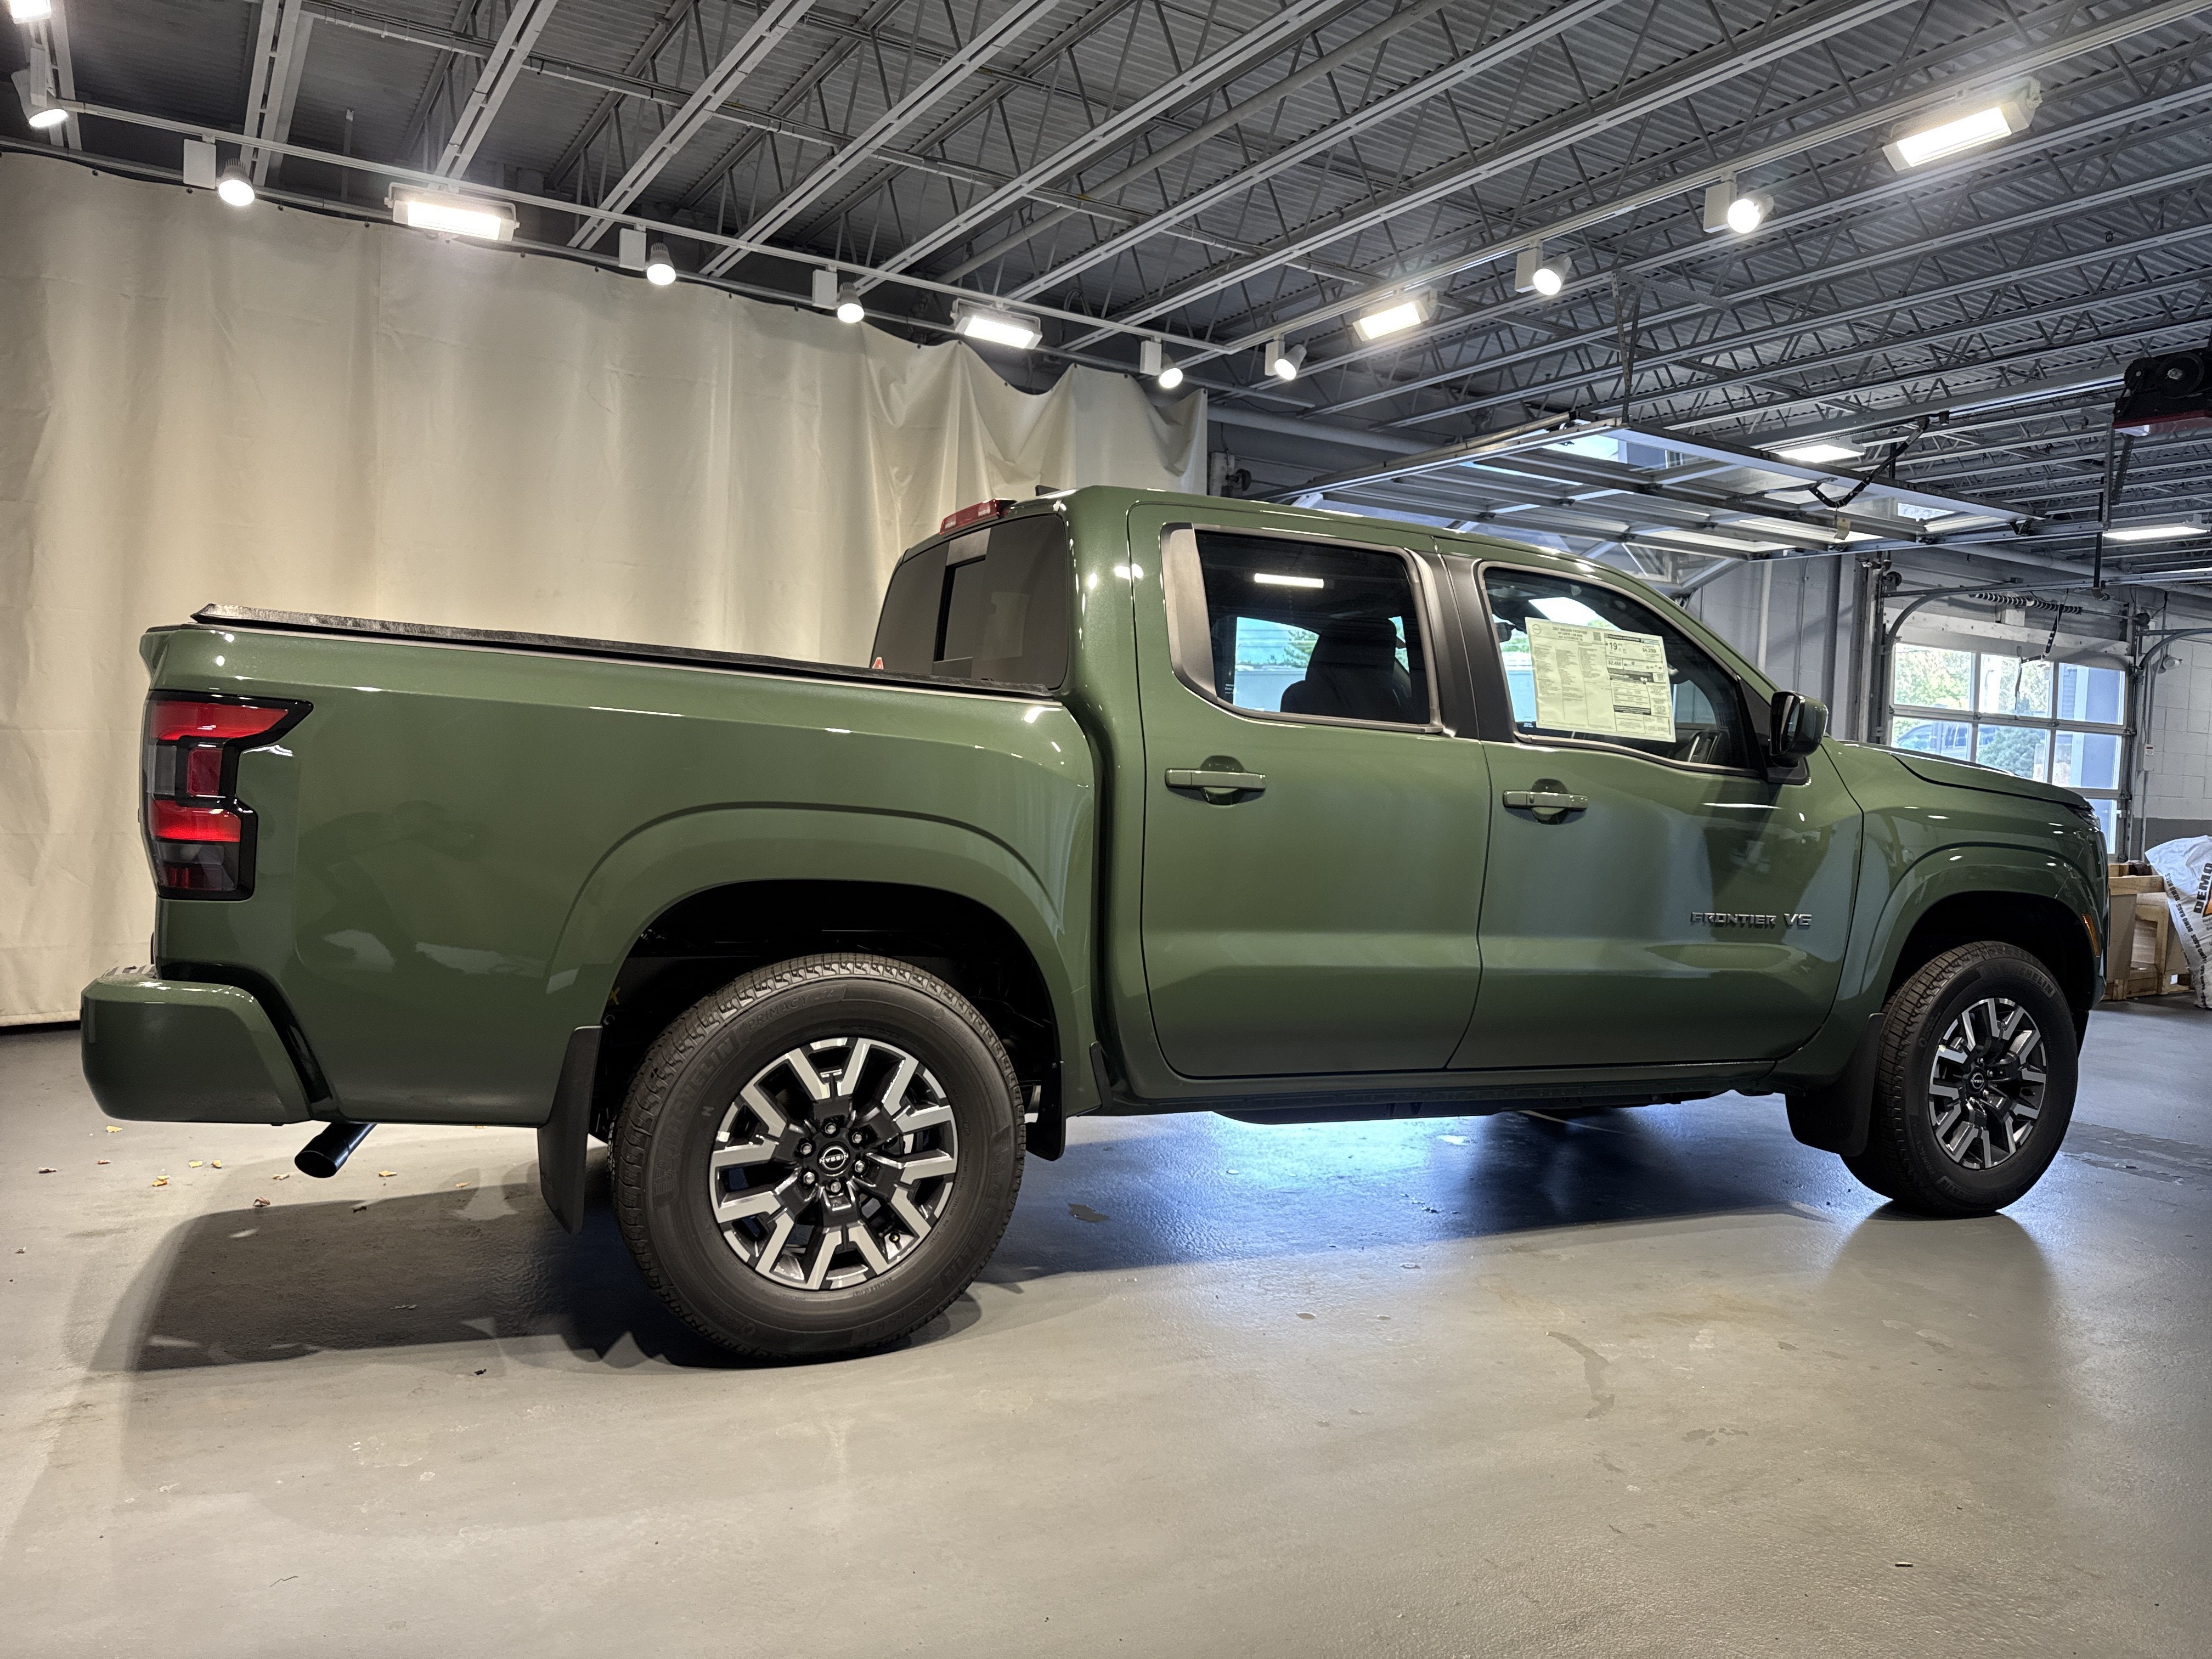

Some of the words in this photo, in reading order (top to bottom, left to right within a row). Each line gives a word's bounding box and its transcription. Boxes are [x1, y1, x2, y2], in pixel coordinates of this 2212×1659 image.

[1609, 642, 1617, 650] 19
[2170, 887, 2181, 901] DEMO
[2193, 862, 2212, 914] DEMO
[2176, 903, 2186, 918] BAGS
[1691, 912, 1777, 926] FRONTIER
[1784, 913, 1812, 926] V6
[2182, 917, 2193, 933] DEMO
[2191, 934, 2201, 949] BAGS
[747, 995, 810, 1031] PRIMACY
